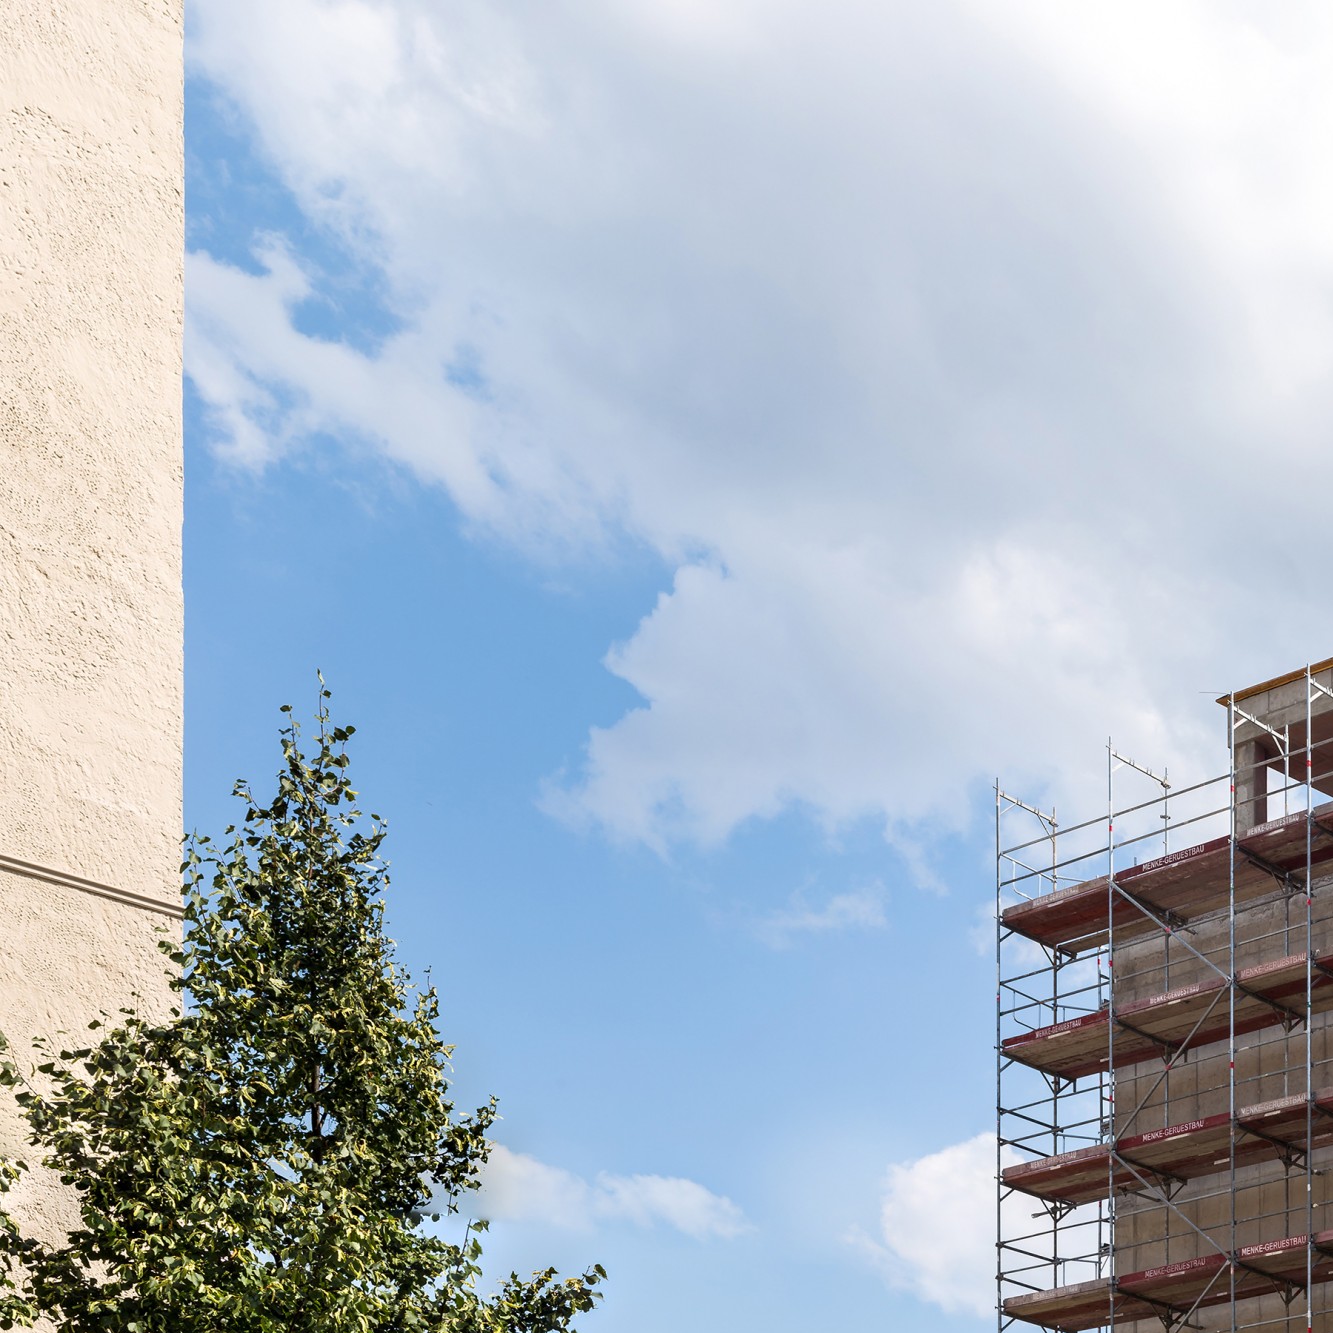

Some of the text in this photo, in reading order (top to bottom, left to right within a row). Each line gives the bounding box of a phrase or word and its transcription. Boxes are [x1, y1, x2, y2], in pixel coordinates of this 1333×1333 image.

[1247, 814, 1300, 836] MENKE-GERUESTBAU
[1142, 844, 1205, 870] MENKE-GERUESTBAU
[1240, 952, 1307, 978] MENKE-GERUESTBAU
[1149, 984, 1200, 1004] MENKE-GERUESTBAU
[1035, 1019, 1082, 1038] MENKE-GERUESTBAU
[1240, 1094, 1306, 1115] MENKE-GERUESTBAU
[1142, 1119, 1205, 1142] MENKE-GERUESTBAU
[1241, 1236, 1306, 1256] MENKE-GERUESTBAU
[1144, 1257, 1206, 1278] MENKE-GERUESTBAU
